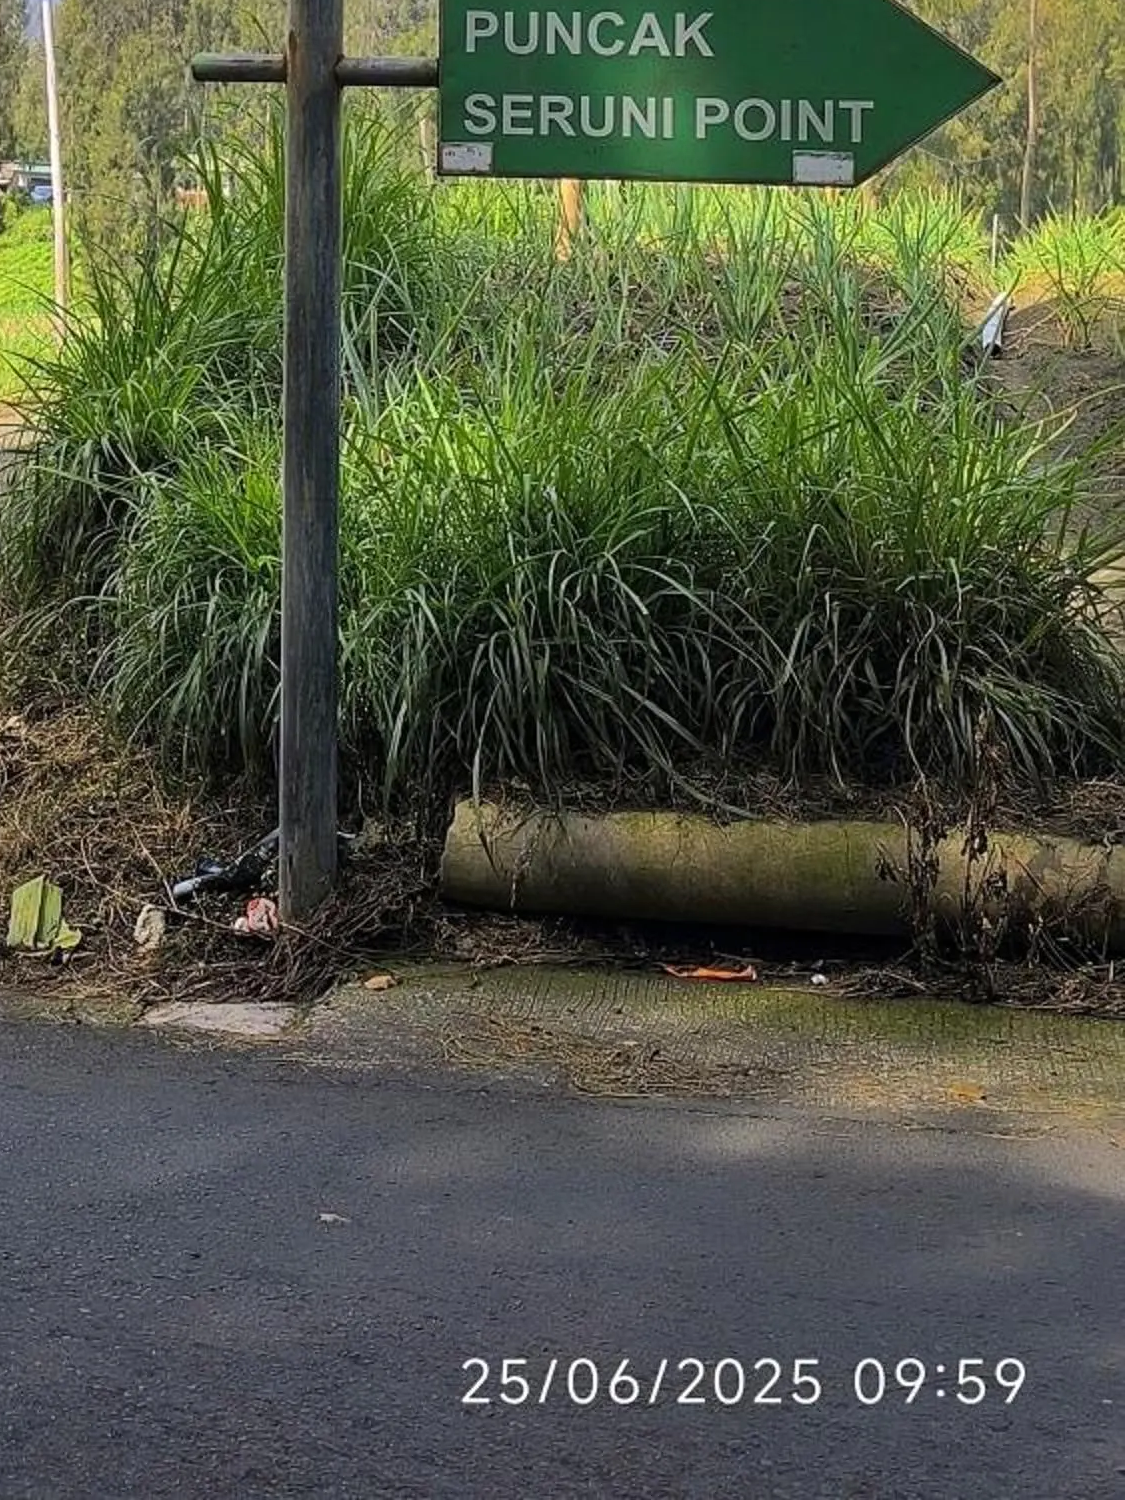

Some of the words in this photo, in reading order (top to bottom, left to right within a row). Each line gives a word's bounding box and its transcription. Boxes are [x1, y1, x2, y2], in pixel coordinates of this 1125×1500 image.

[465, 10, 714, 57] PUNCAK
[463, 93, 674, 139] SERUNI
[695, 98, 874, 143] POINT
